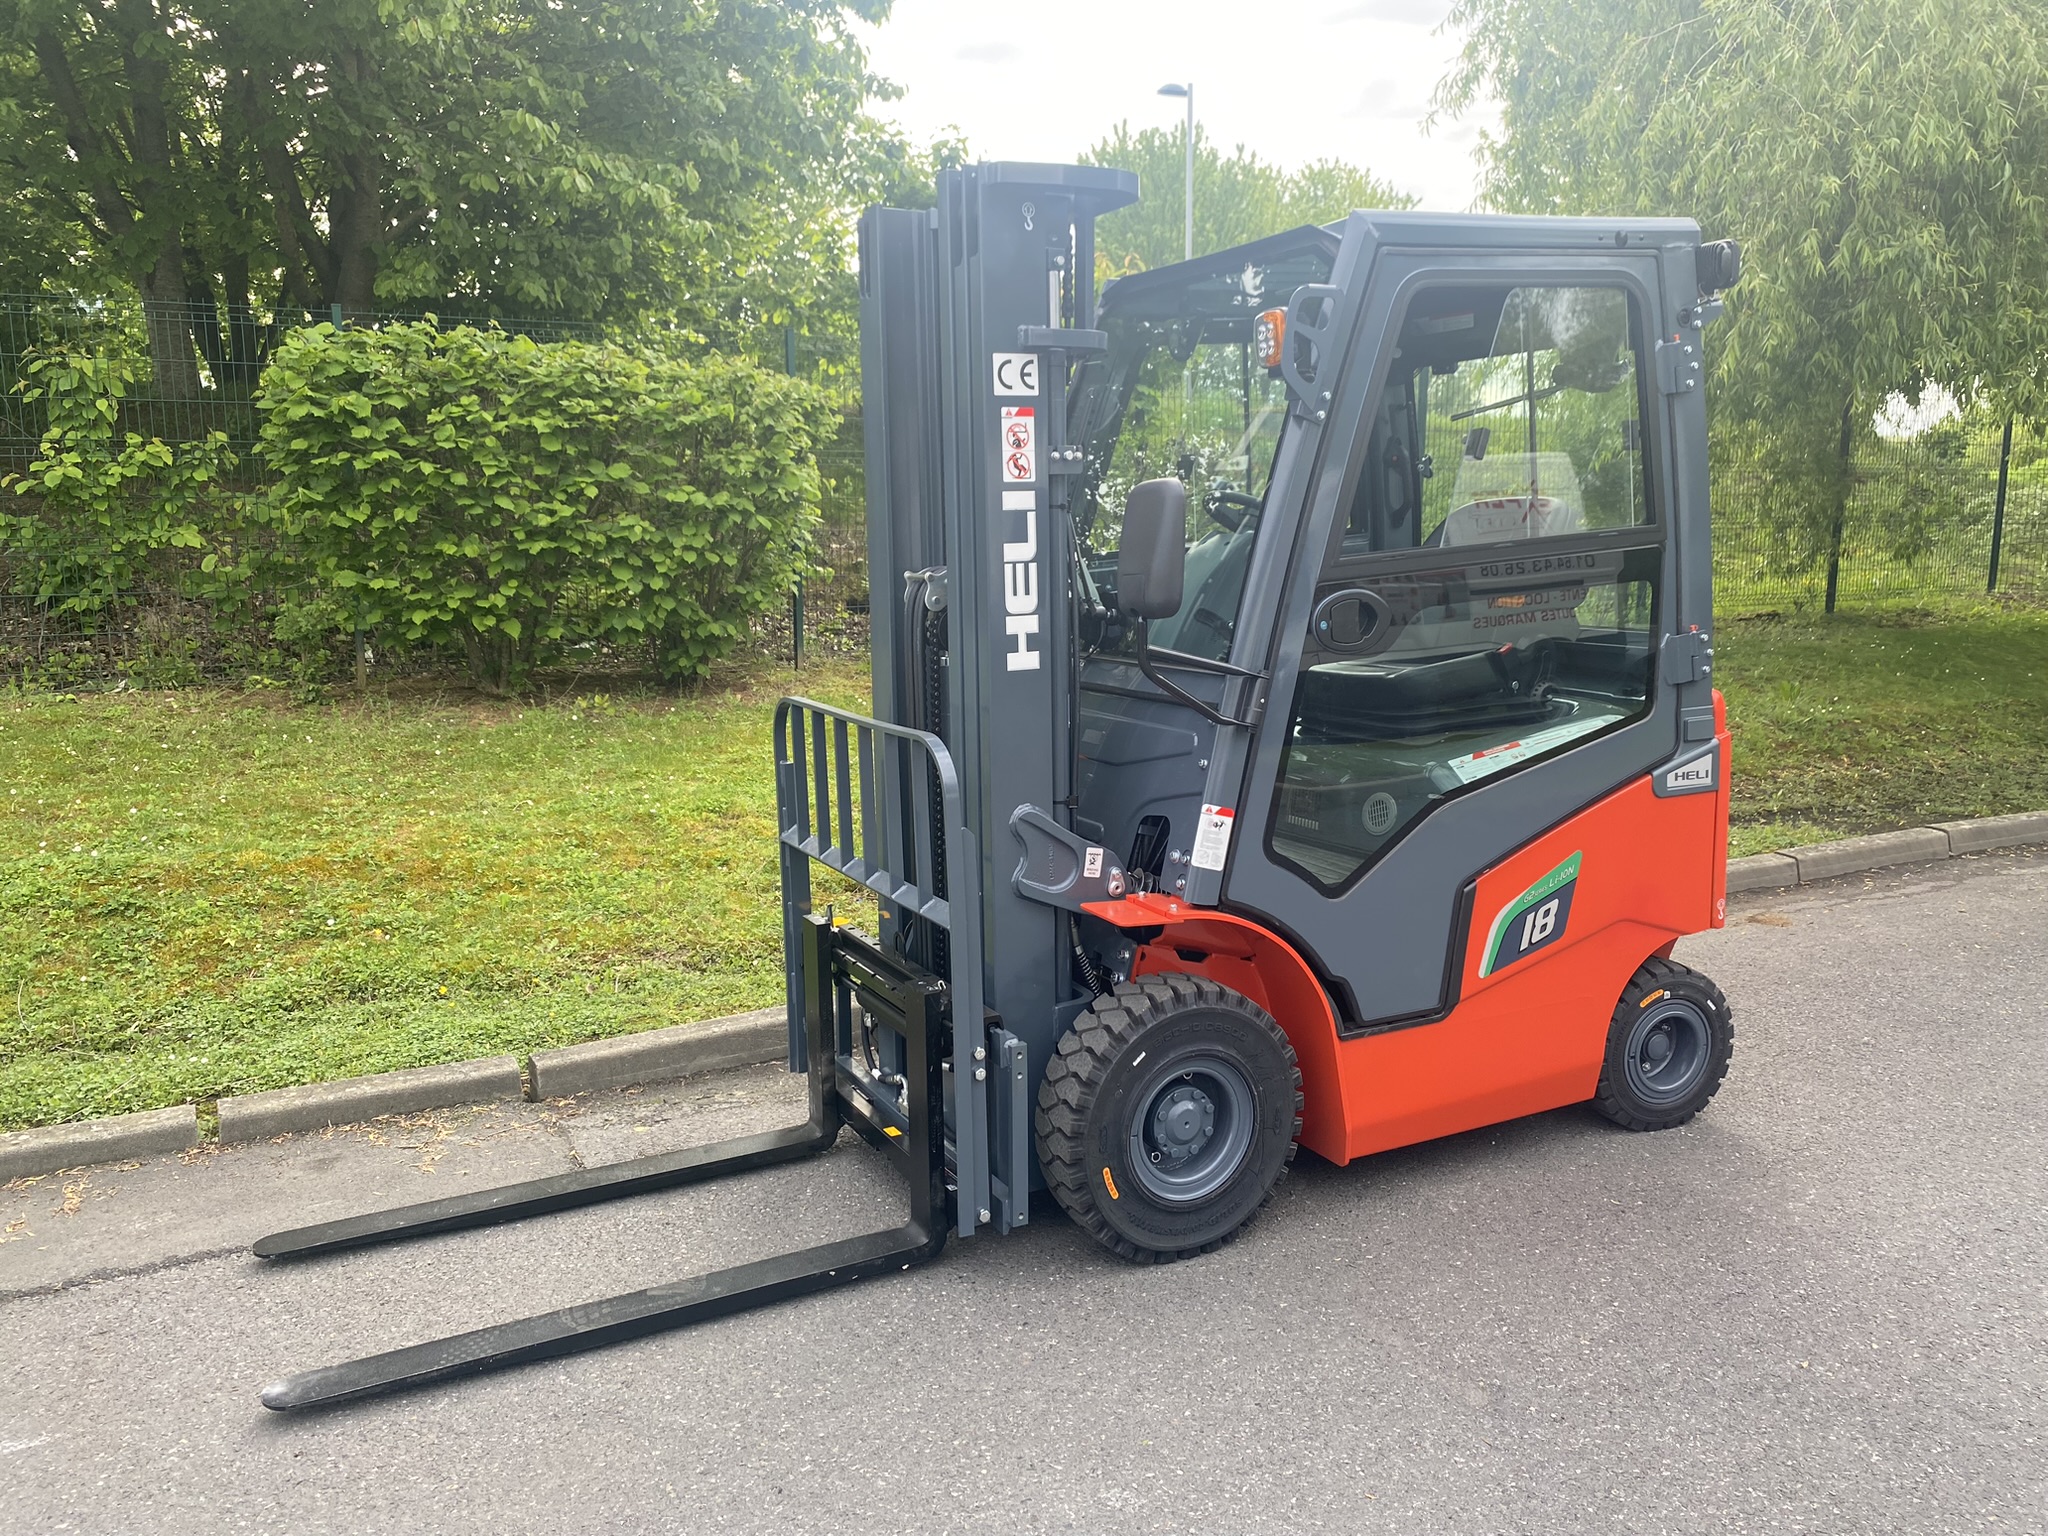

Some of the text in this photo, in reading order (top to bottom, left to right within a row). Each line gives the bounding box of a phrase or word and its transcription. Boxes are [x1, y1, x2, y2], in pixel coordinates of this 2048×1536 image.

[997, 359, 1035, 390] CE
[1002, 490, 1040, 671] HELI
[1674, 769, 1709, 782] HELI
[1519, 898, 1559, 952] 18
